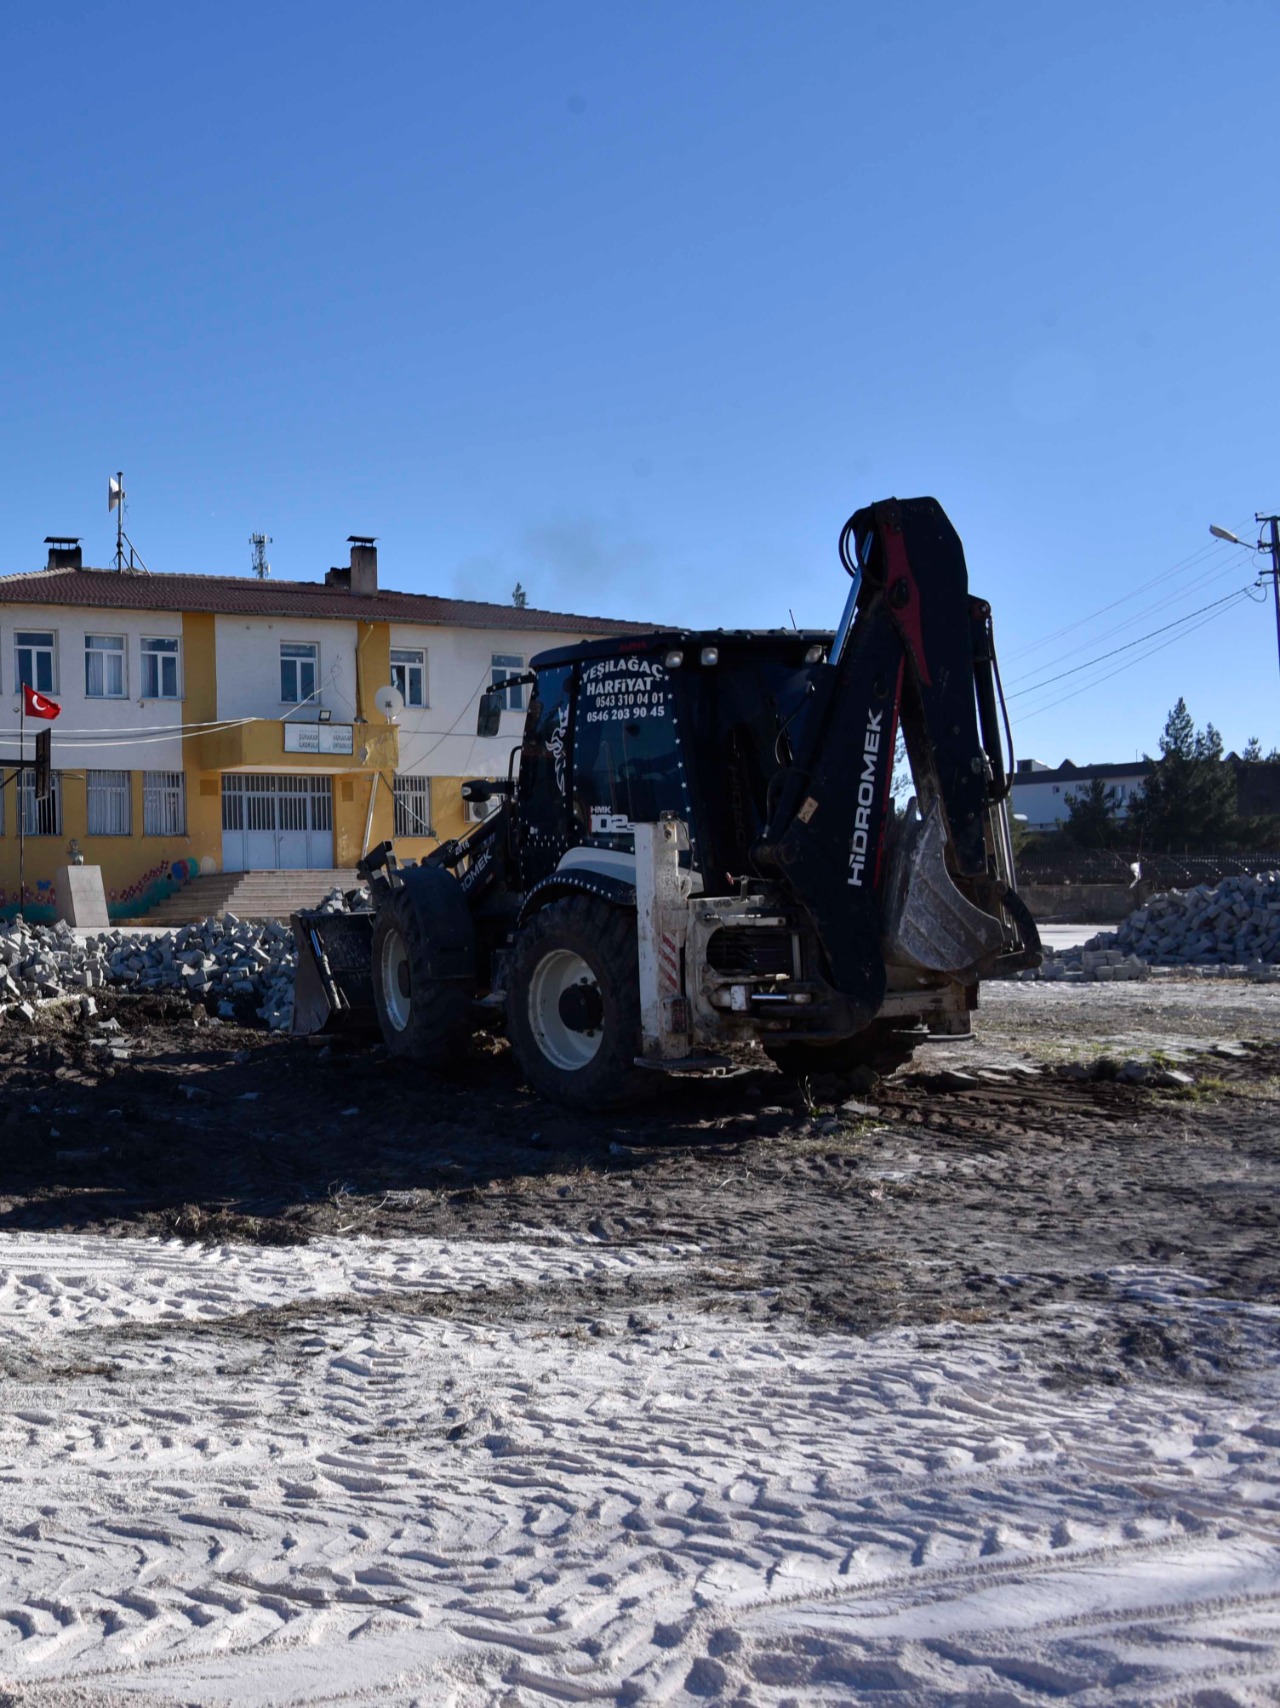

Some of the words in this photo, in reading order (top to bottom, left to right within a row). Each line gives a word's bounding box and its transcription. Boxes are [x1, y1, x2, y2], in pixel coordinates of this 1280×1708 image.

[582, 655, 663, 683] YEŞİLAĞAÇ
[586, 677, 654, 696] HARFİYAT
[595, 695, 615, 708] 0543
[617, 694, 634, 706] 310
[636, 693, 648, 705] 04
[651, 692, 664, 704] 01
[587, 710, 608, 722] 0546
[611, 708, 630, 720] 203
[633, 707, 647, 718] 90
[650, 706, 665, 717] 45
[847, 707, 883, 886] HİDROMEK
[590, 805, 611, 814] HMK
